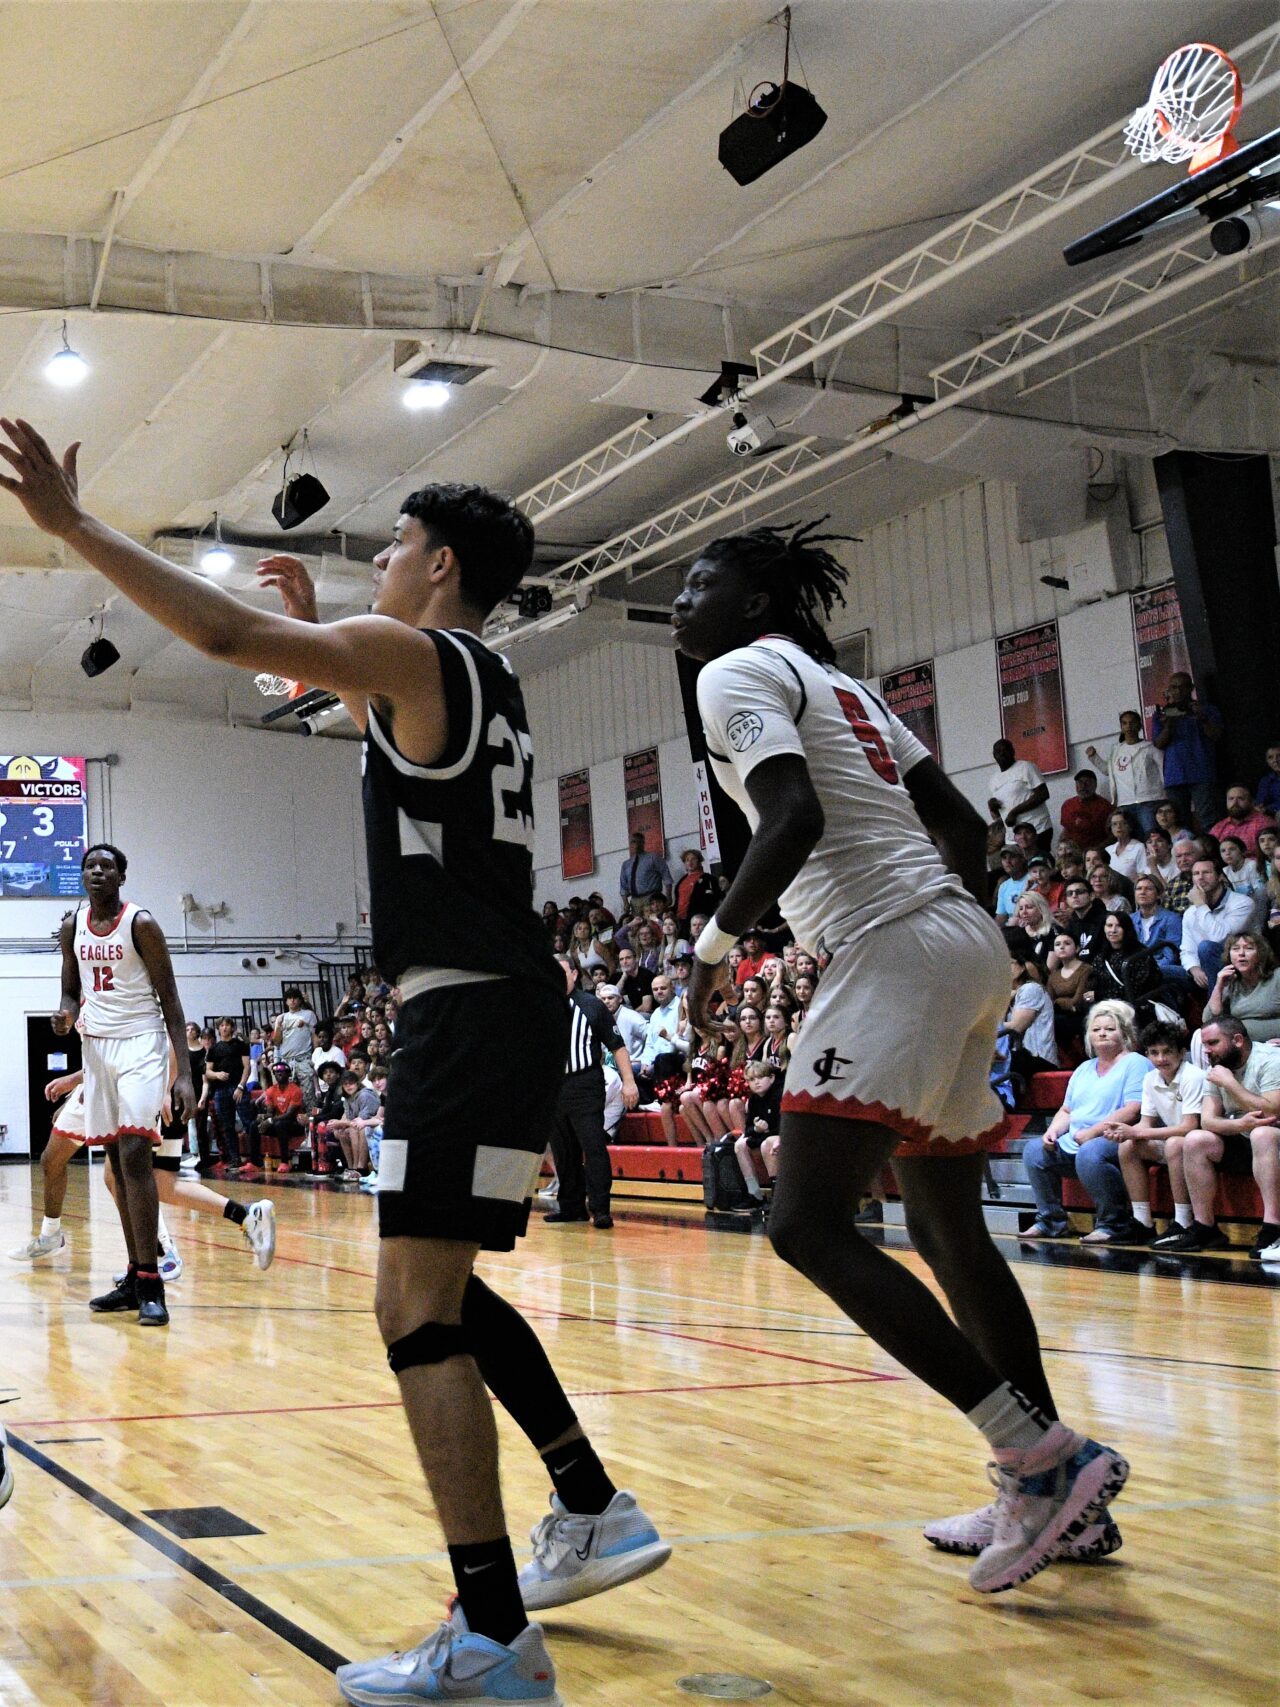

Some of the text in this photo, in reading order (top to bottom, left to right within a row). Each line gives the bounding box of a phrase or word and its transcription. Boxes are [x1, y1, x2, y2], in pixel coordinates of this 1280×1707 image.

[729, 718, 757, 741] EYBL
[831, 685, 898, 786] 5
[20, 783, 81, 797] VICTORS
[487, 712, 535, 846] 2
[32, 806, 55, 837] 3
[700, 790, 715, 843] HOME
[54, 840, 80, 848] FOULS
[63, 848, 73, 861] 1
[79, 944, 124, 961] EAGLES
[92, 966, 116, 992] 12
